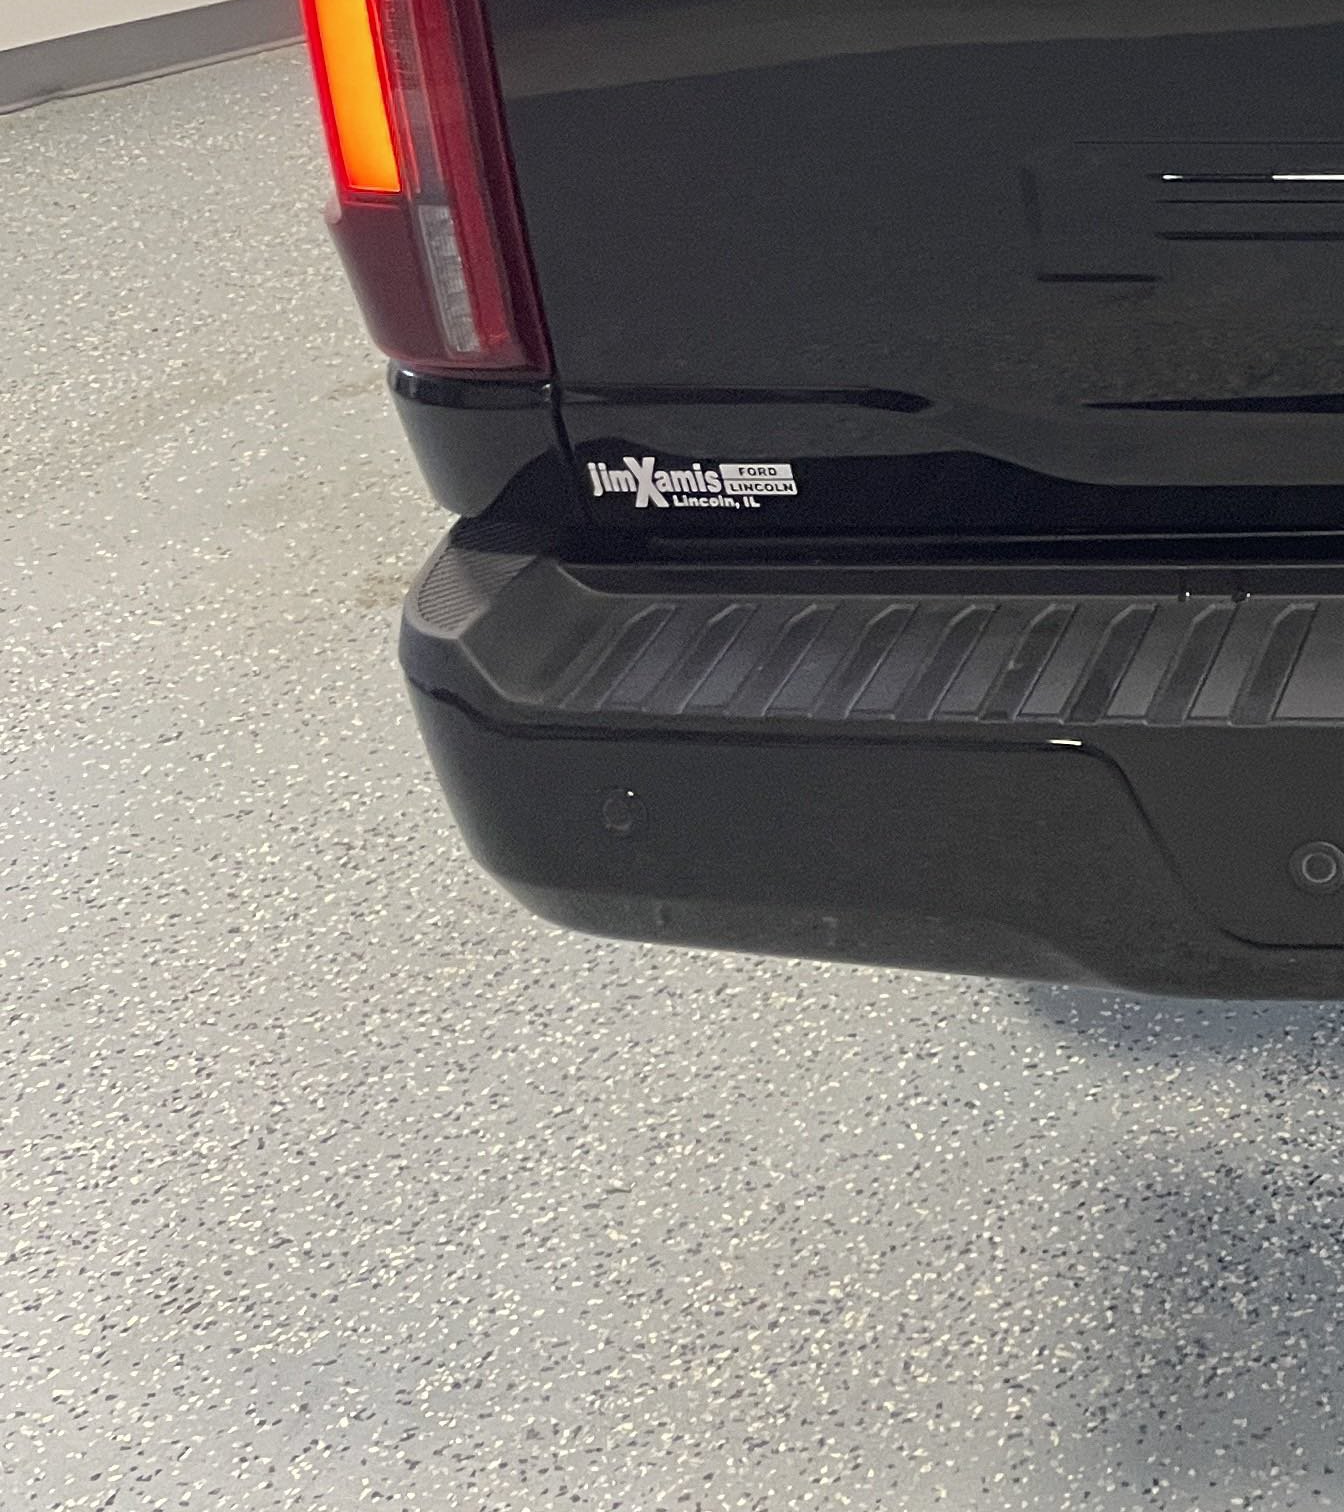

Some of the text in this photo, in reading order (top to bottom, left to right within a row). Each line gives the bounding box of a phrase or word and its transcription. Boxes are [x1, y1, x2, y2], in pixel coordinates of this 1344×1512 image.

[738, 467, 777, 476] FORD
[730, 482, 793, 492] LINCOLN
[743, 496, 761, 508] IL
